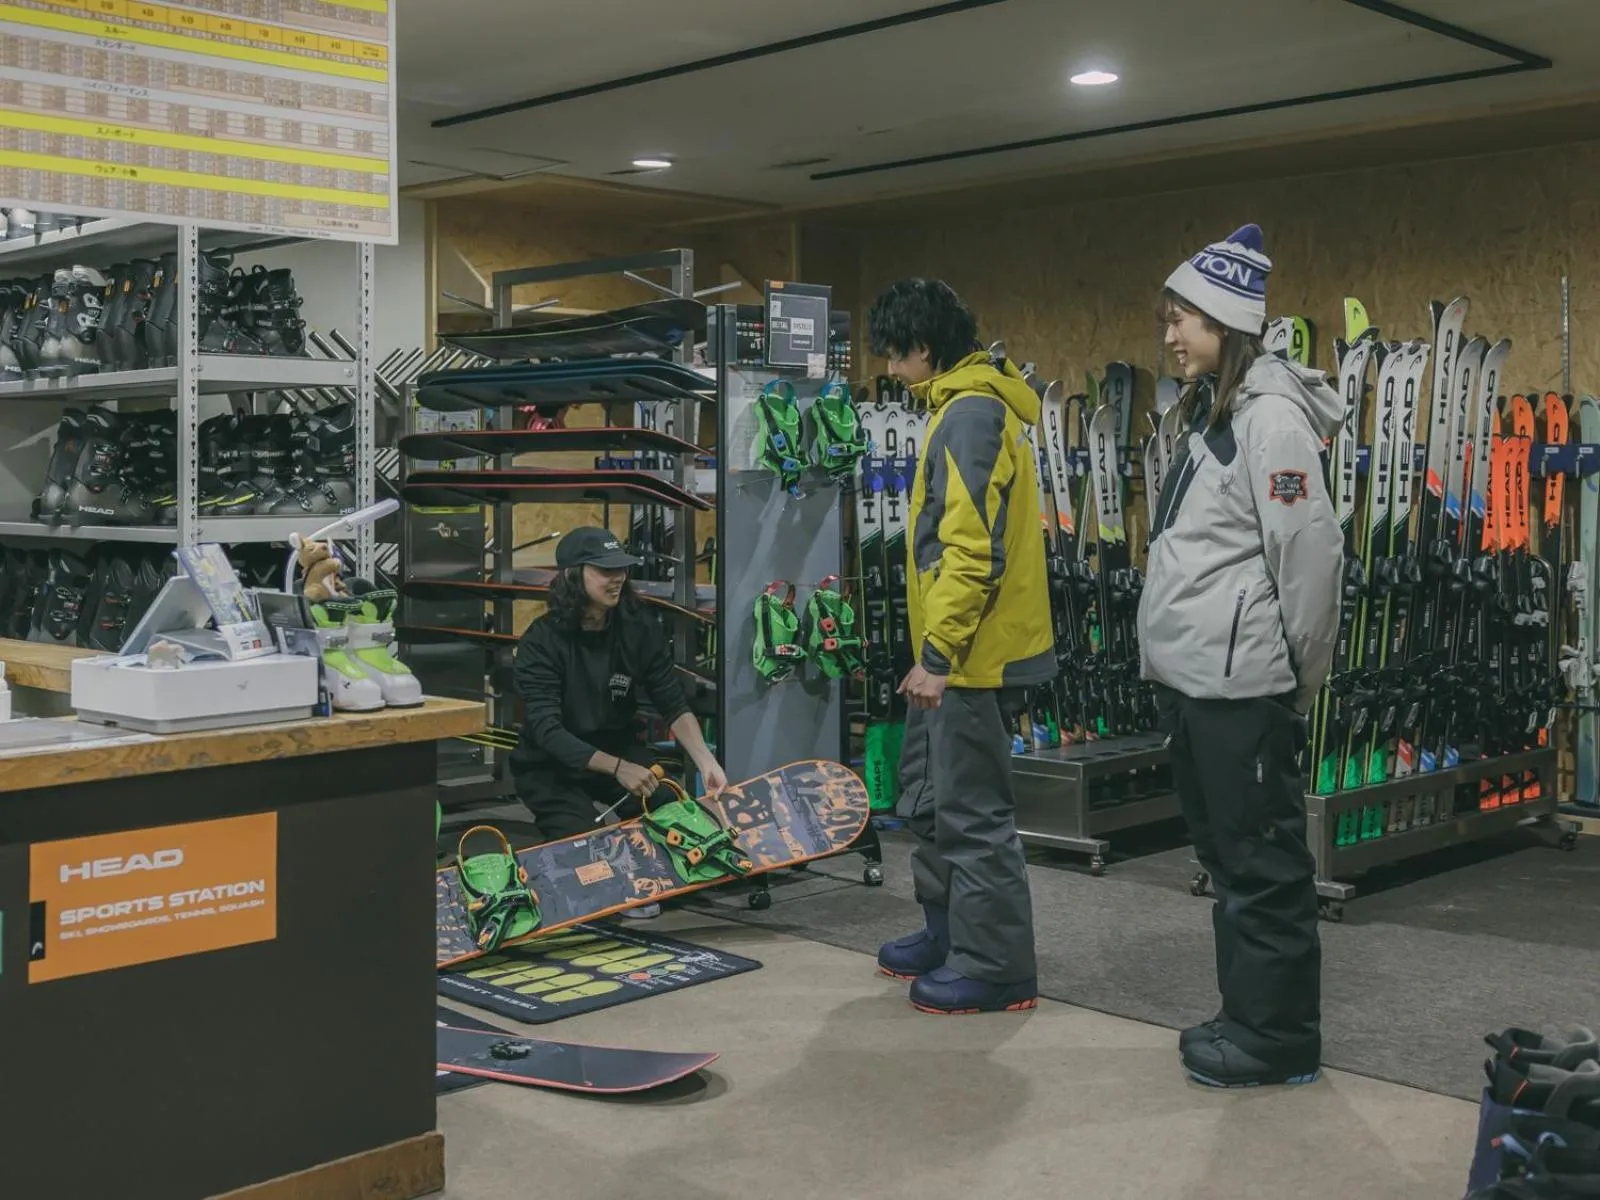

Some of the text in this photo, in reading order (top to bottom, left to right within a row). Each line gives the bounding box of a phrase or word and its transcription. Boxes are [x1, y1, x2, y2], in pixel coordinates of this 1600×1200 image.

[1439, 329, 1453, 424] HEAD
[1456, 367, 1470, 461] HEAD
[1480, 369, 1496, 461] HEAD
[1050, 410, 1066, 493] HEAD
[1098, 432, 1111, 515] HEAD
[1343, 373, 1356, 502] HEAD
[1378, 375, 1395, 504] HEAD
[1399, 377, 1415, 503] HEAD
[79, 504, 115, 515] HEAD
[1516, 461, 1526, 527] HEAD
[59, 878, 266, 926] SPORTS STATION
[60, 848, 184, 883] HEAD
[218, 898, 266, 913] SQUASH
